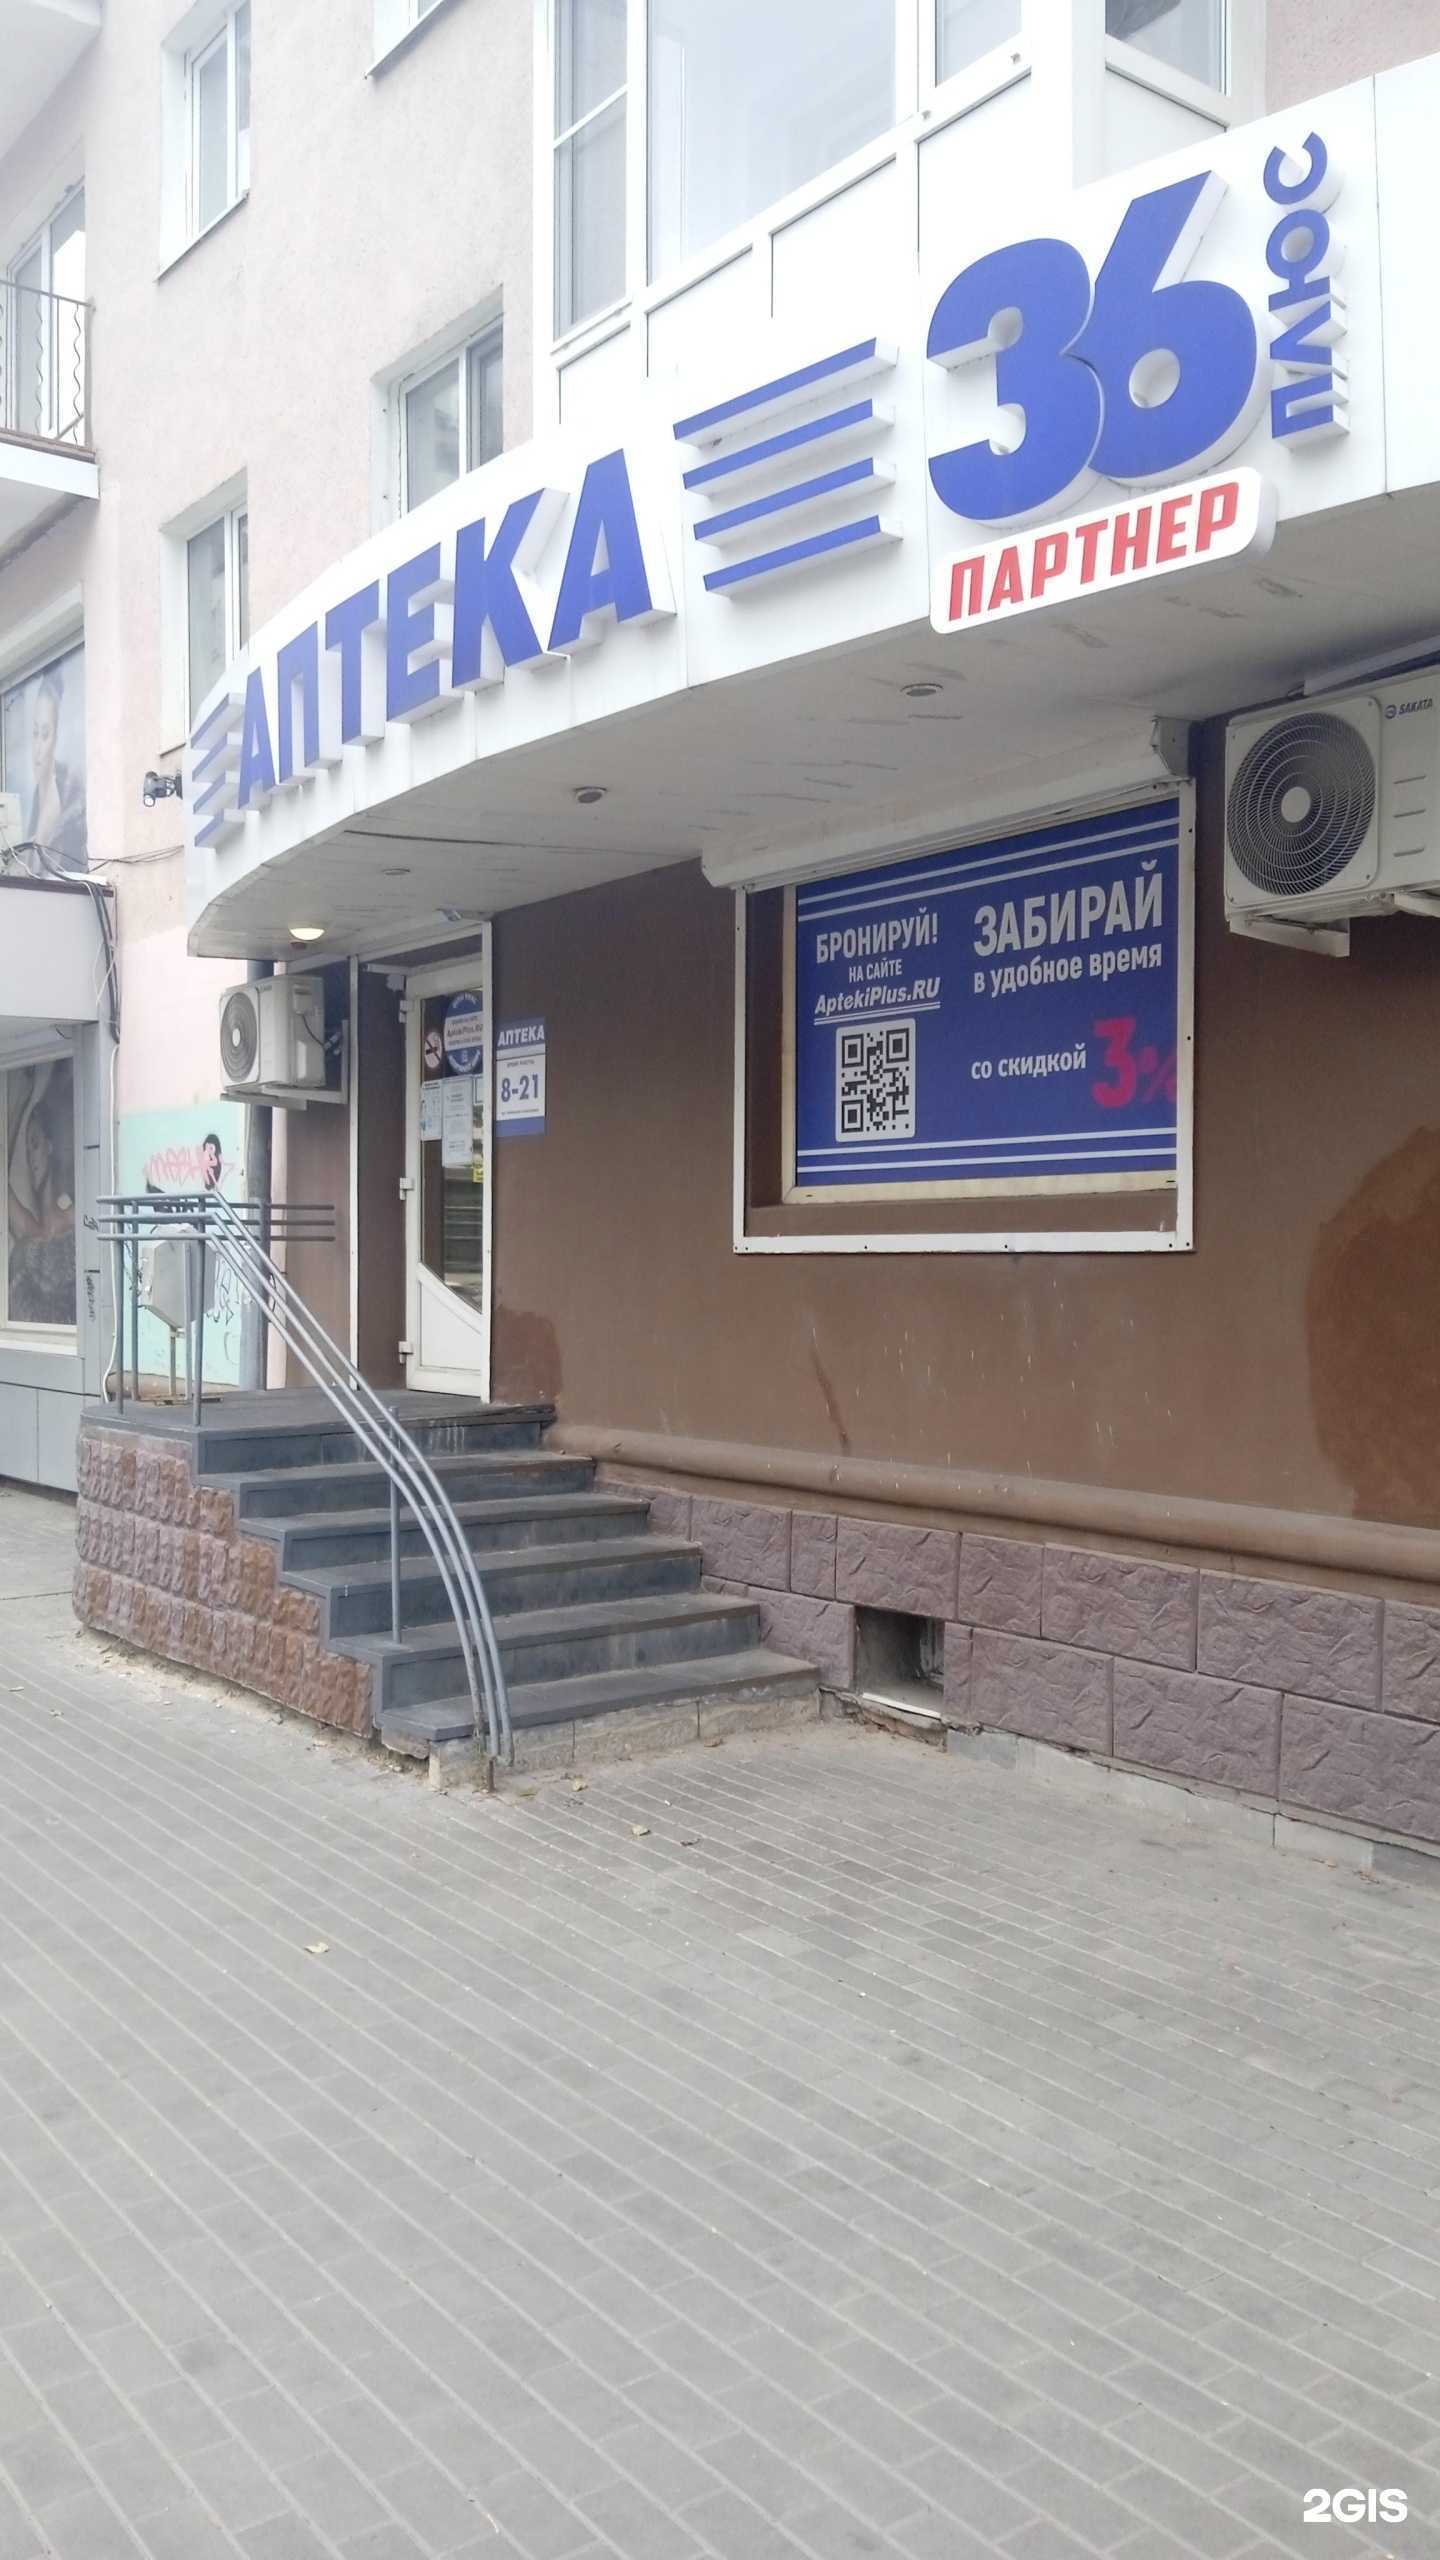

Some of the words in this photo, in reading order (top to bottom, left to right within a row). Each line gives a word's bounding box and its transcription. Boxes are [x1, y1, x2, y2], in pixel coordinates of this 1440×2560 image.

[1263, 132, 1335, 438] ПЛЮС
[927, 170, 1258, 521] 36
[948, 481, 1240, 622] ПАРТНЕР
[238, 448, 653, 810] АПТЕКА
[816, 906, 939, 964] БРОНИРУЙ!
[973, 859, 1163, 957] ЗАБИРАЙ
[814, 977, 941, 1016] AptekiPlus.RU
[848, 965, 864, 983] НА
[866, 957, 903, 980] САЙТЕ
[974, 971, 985, 993] в
[990, 955, 1083, 998] удобное
[1089, 943, 1162, 982] время
[497, 1024, 545, 1048] АПТЕКА
[971, 1060, 992, 1080] со
[998, 1042, 1086, 1078] скидкой
[501, 1073, 538, 1102] 8-21
